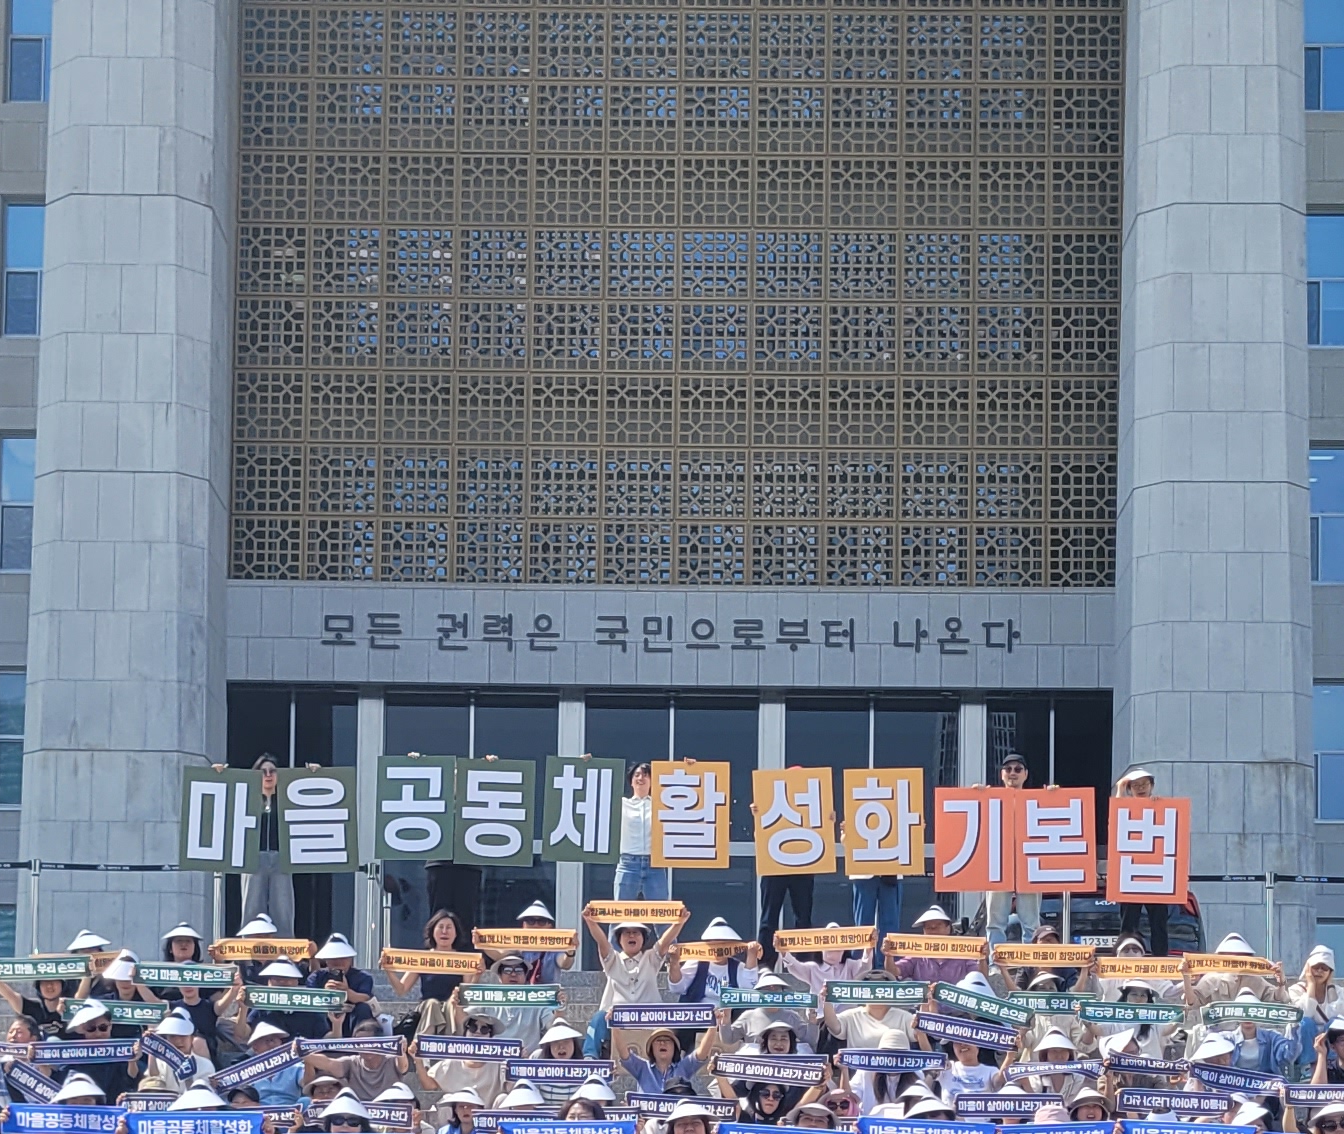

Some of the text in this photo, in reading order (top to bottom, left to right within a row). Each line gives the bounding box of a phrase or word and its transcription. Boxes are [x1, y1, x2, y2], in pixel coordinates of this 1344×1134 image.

[321, 612, 1021, 654] 모든 권력은 국민으로부터 나온다
[624, 908, 648, 917] 마을이
[814, 935, 838, 945] 마을이
[38, 963, 56, 973] 우리
[420, 958, 444, 968] 마을이
[140, 969, 158, 979] 우리
[184, 970, 202, 981] 우리
[464, 991, 483, 1001] 우리
[485, 991, 506, 1002] 마을,
[508, 990, 526, 1000] 우리
[832, 987, 923, 999] 우리 마을, 우리 손으로
[614, 1010, 712, 1022] 마을이 살아야 나라가 산다
[420, 1041, 520, 1056] 마을이 살아야 나라가 산다
[717, 1061, 822, 1080] 마을이 살아야 나라가 산다
